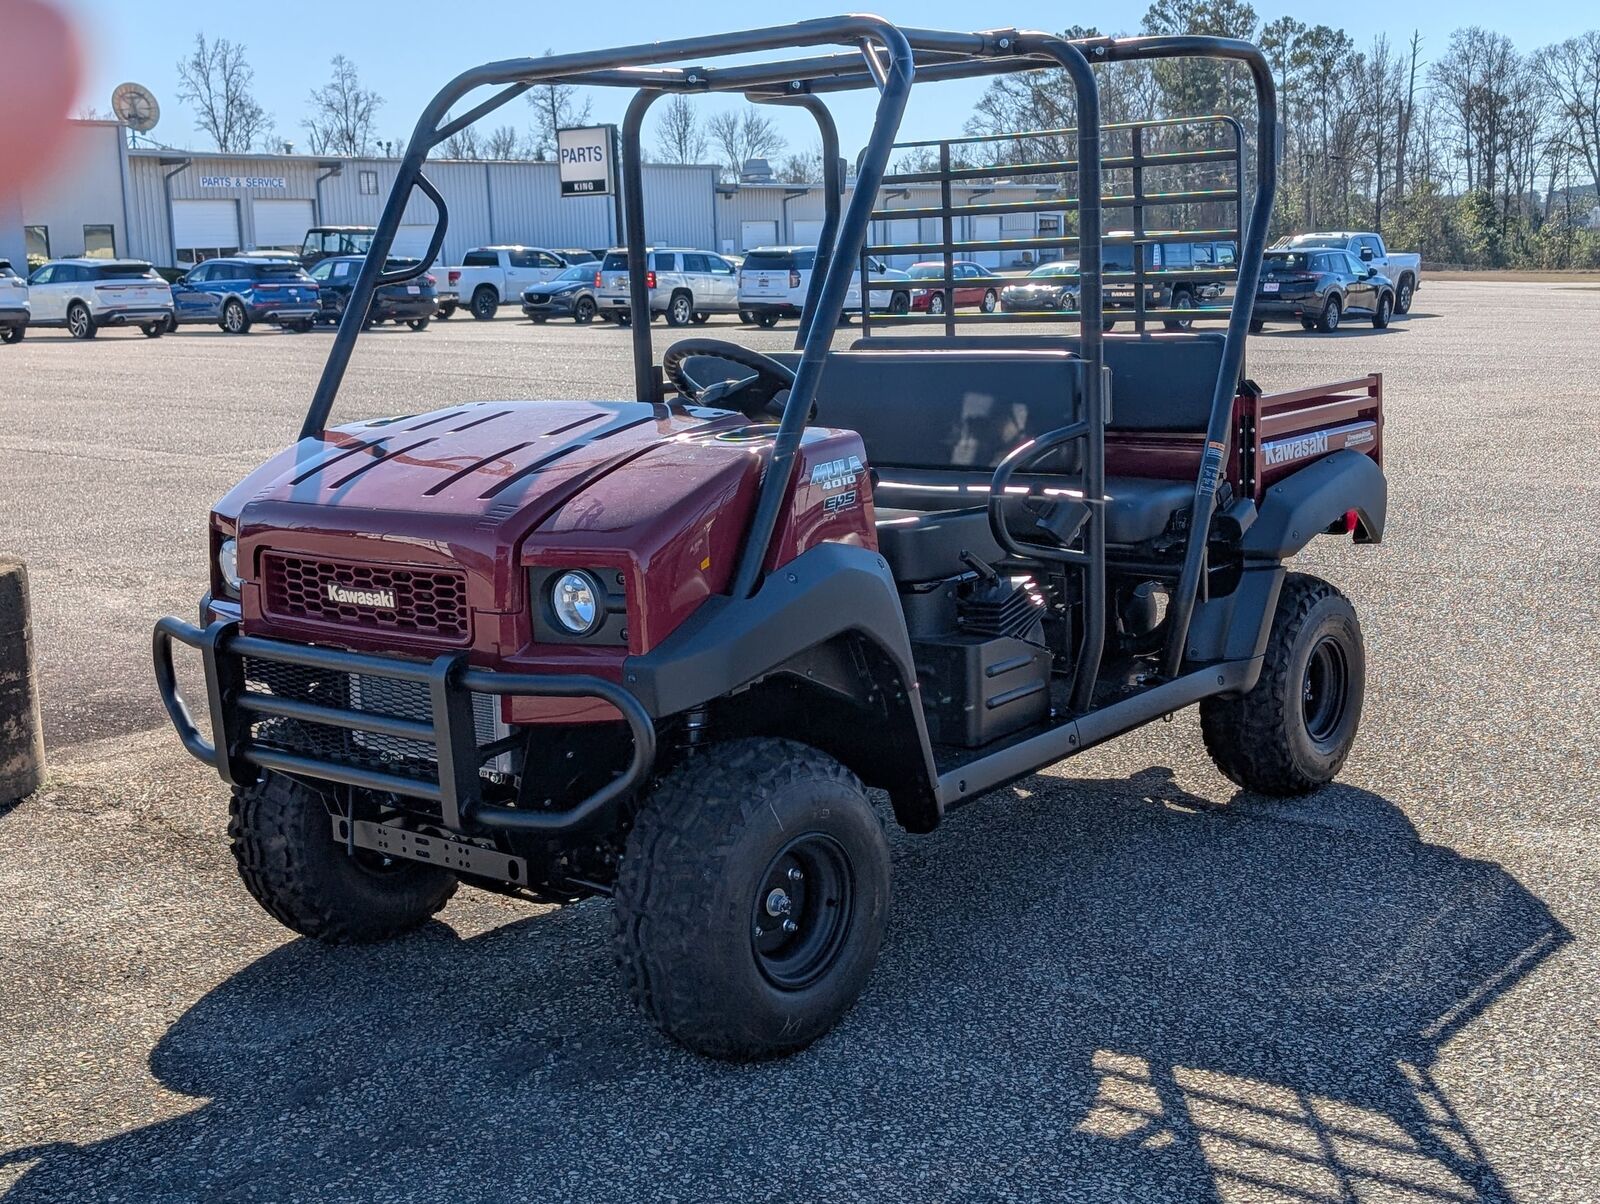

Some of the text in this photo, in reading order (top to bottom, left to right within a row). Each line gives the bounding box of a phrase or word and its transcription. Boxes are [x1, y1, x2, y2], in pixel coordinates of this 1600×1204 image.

[561, 145, 603, 164] PARTS
[201, 177, 284, 188] PARTS & SERVICE
[573, 182, 594, 191] KING
[1262, 430, 1329, 465] Kawasaki
[810, 455, 865, 485] MULE
[822, 474, 857, 490] 4010
[327, 584, 395, 608] Kawasaki
